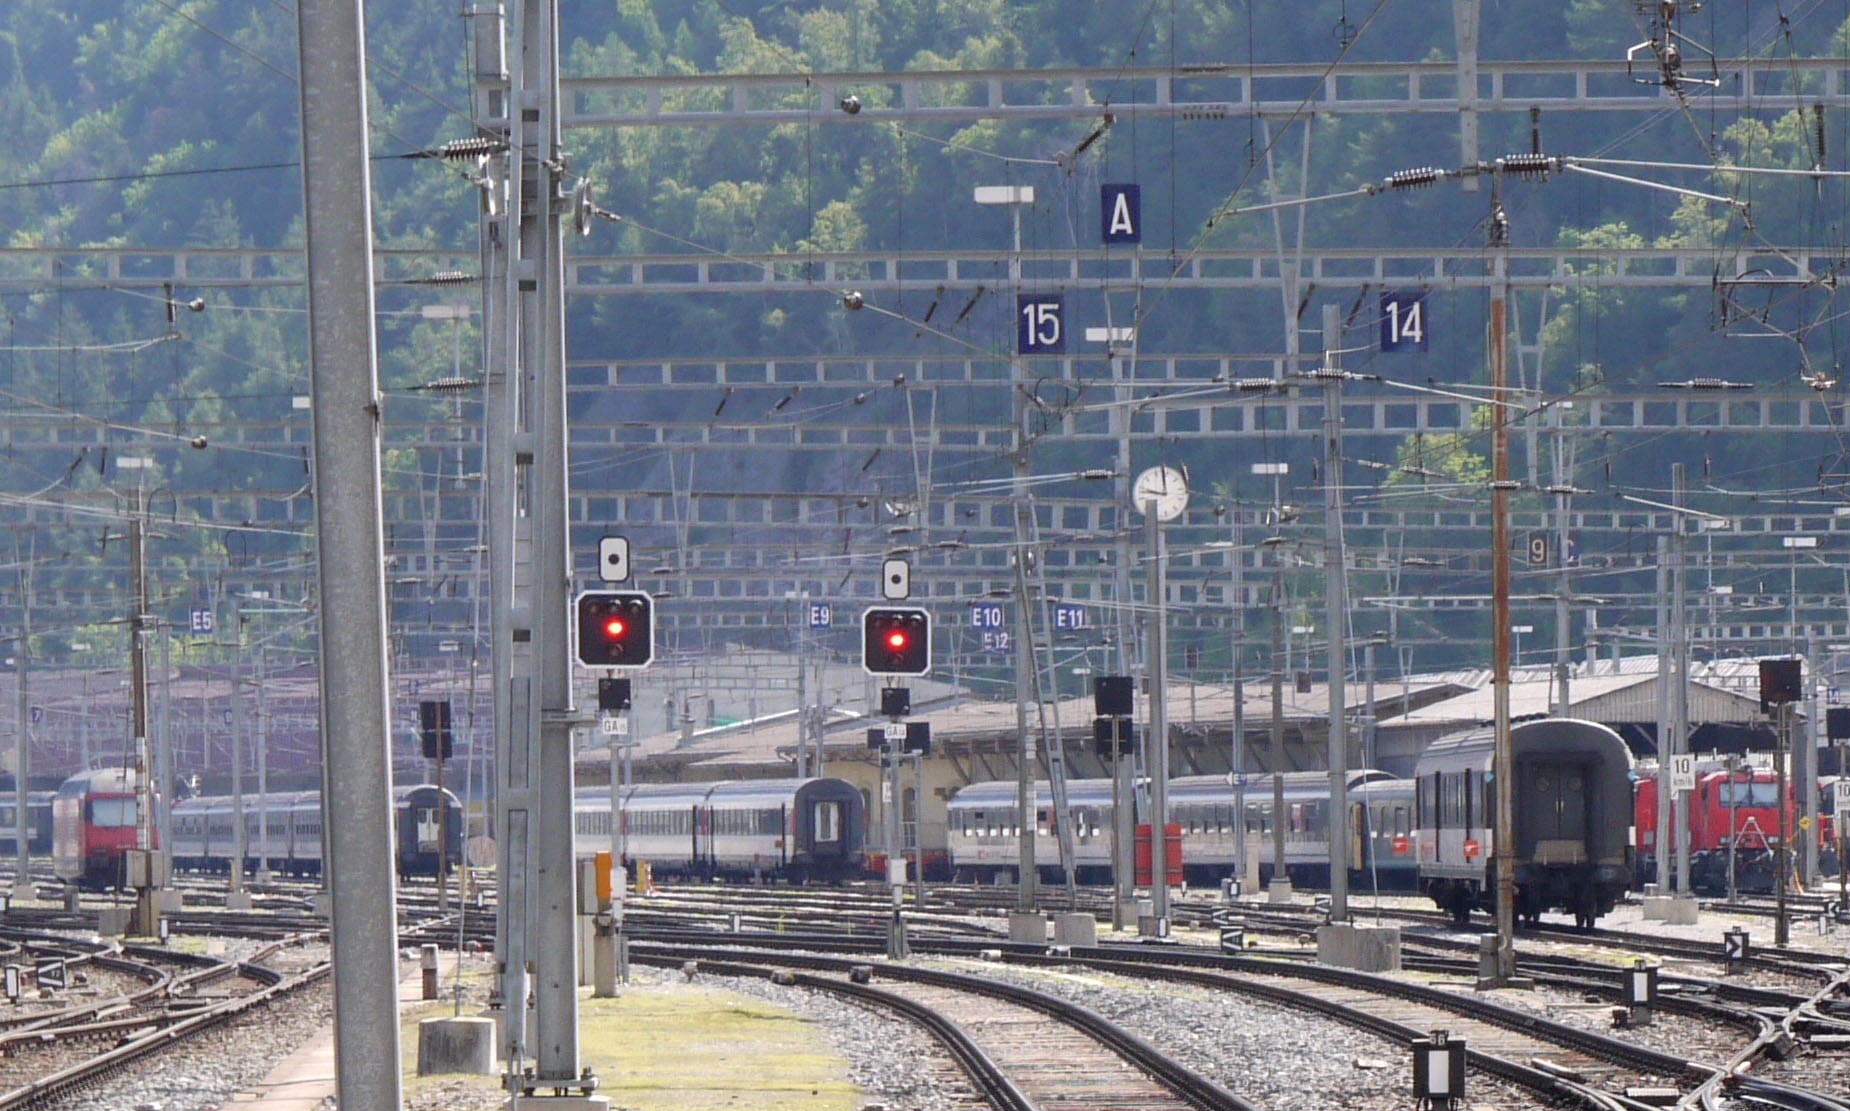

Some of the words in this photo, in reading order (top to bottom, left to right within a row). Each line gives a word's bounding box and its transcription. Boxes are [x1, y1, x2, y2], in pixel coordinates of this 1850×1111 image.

[1110, 192, 1133, 235] A
[1023, 303, 1060, 345] 15
[1386, 301, 1423, 343] 14
[1532, 539, 1545, 562] 9
[192, 611, 212, 630] E5
[811, 605, 829, 625] E9
[973, 607, 1001, 627] E10
[1057, 608, 1083, 627] E11
[1676, 758, 1690, 774] 10
[1839, 784, 1850, 797] 10
